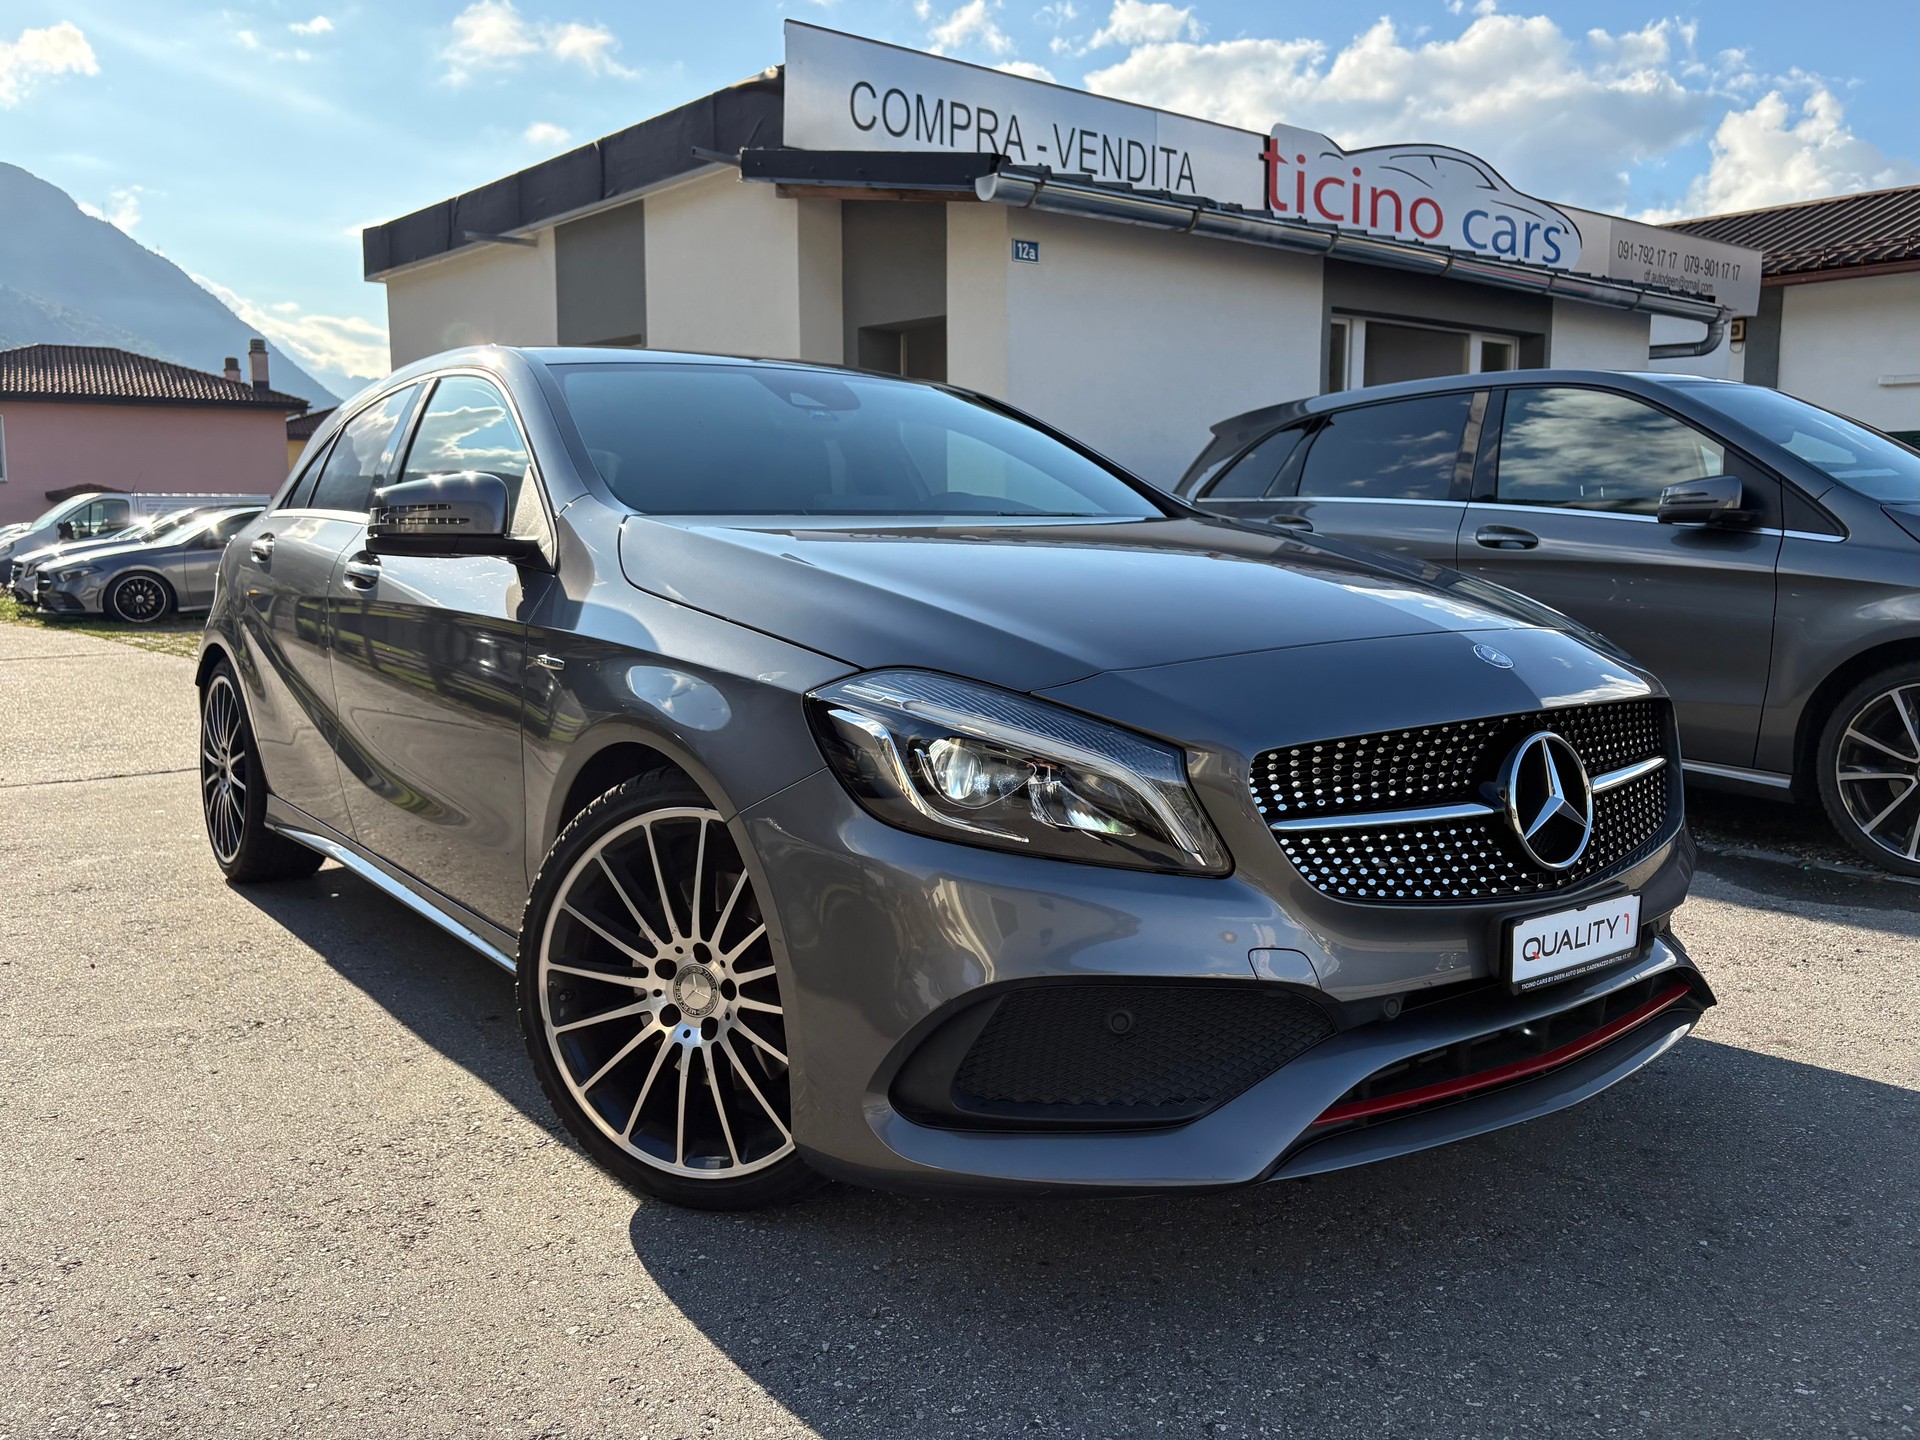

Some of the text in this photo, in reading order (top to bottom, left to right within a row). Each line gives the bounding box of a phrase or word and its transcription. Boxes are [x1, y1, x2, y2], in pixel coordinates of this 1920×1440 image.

[850, 81, 1026, 161] COMPRA
[1053, 123, 1196, 194] VENDITA
[1263, 138, 1561, 264] ticino cars
[1017, 242, 1036, 260] 12a
[1618, 240, 1678, 270] 091-792 17 17
[1684, 254, 1741, 281] 079-901 17 17
[1522, 912, 1630, 962] QUALITY 1
